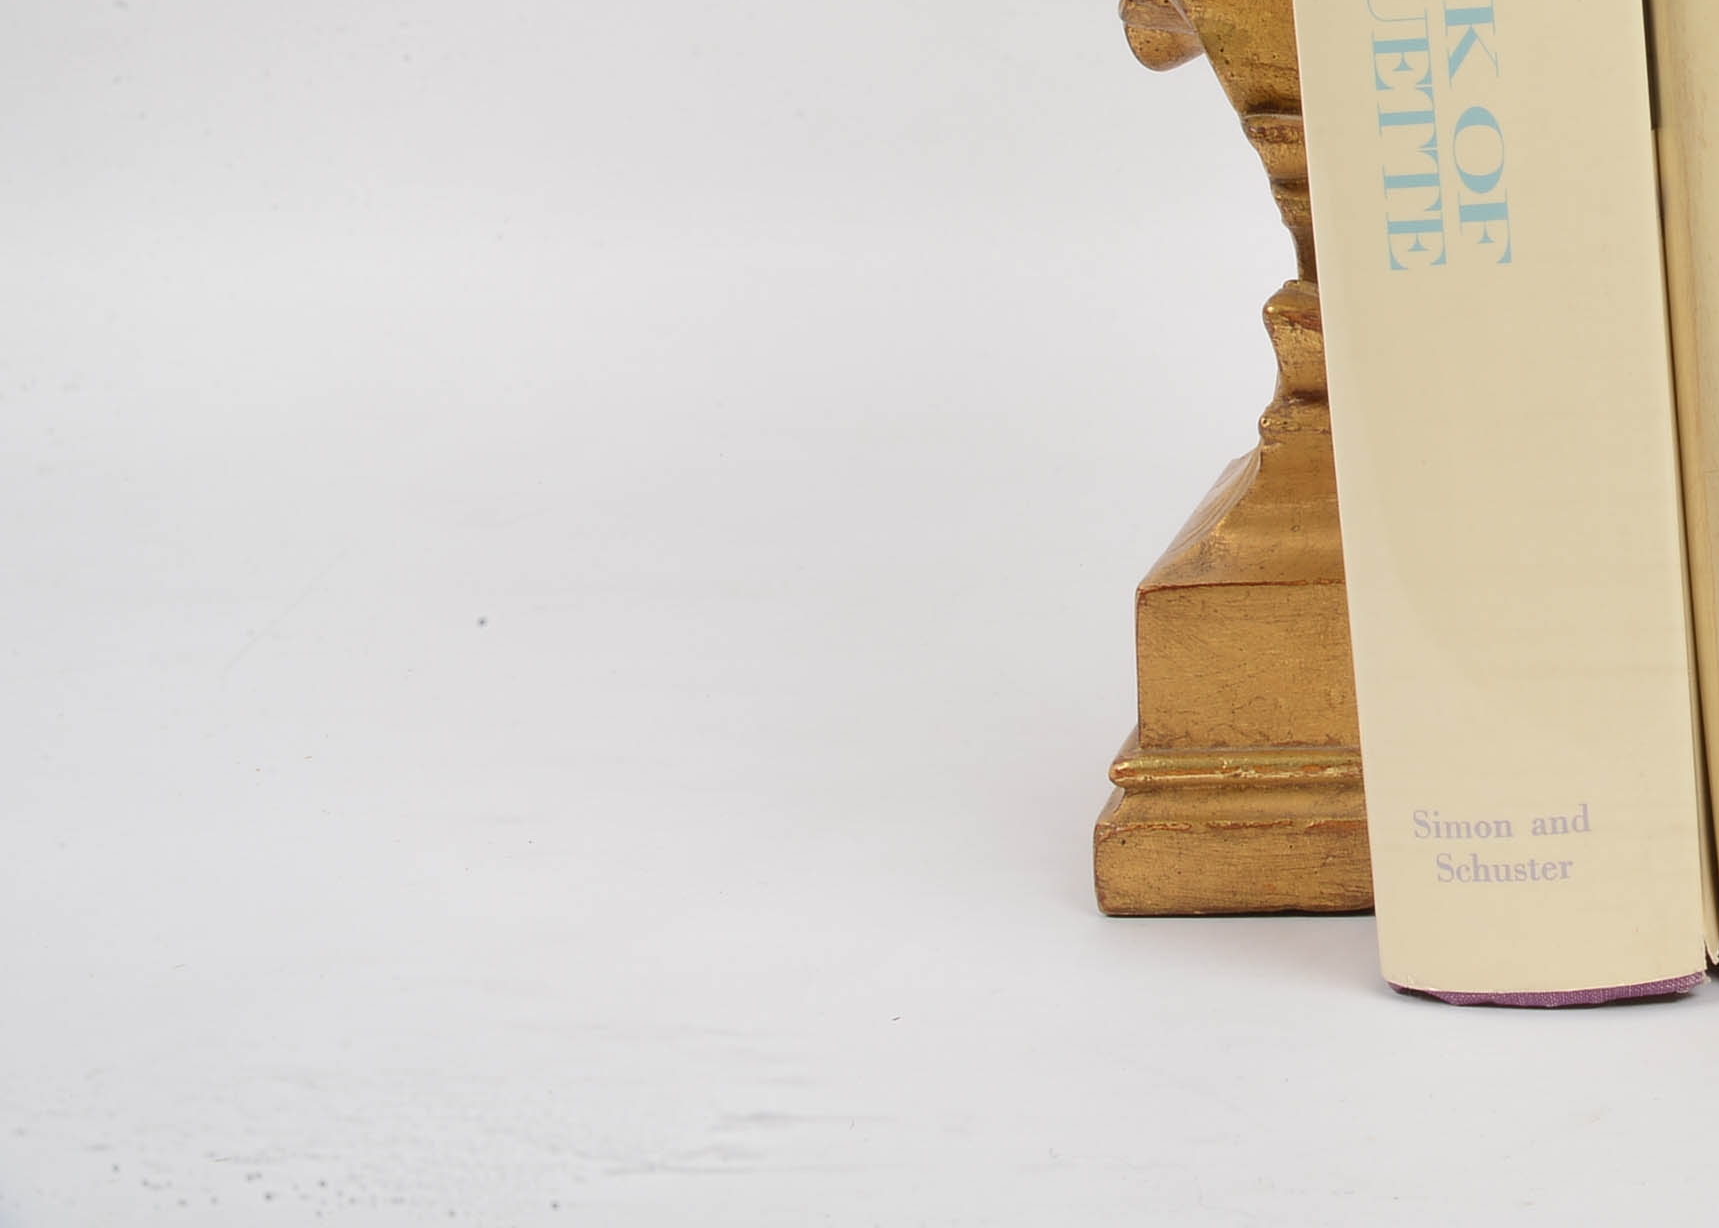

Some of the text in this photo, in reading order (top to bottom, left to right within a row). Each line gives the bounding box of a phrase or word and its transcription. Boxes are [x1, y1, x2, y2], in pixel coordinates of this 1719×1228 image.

[1453, 106, 1512, 264] OF
[1412, 804, 1591, 839] Simon and
[1436, 853, 1574, 883] Schuster
